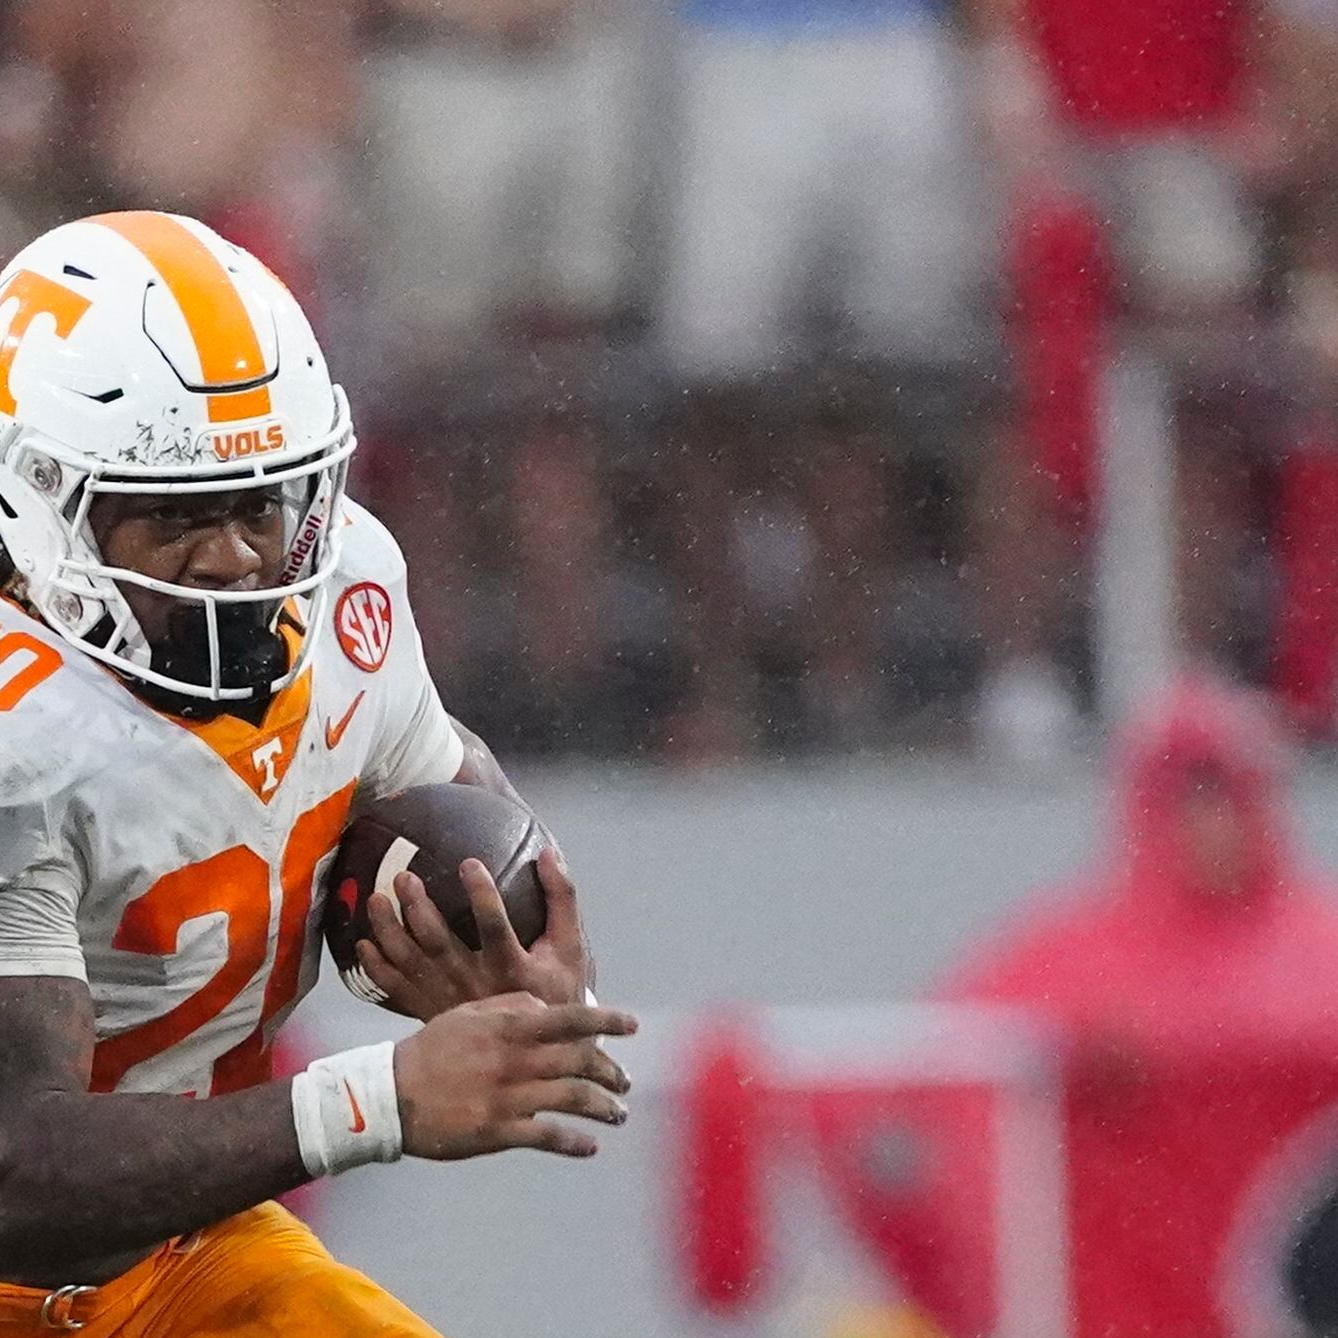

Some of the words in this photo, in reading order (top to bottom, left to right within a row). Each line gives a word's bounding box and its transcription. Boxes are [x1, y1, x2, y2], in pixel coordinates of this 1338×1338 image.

[213, 425, 284, 461] VOLS
[277, 513, 323, 587] Riddell
[339, 587, 390, 668] SEC
[251, 735, 283, 793] T
